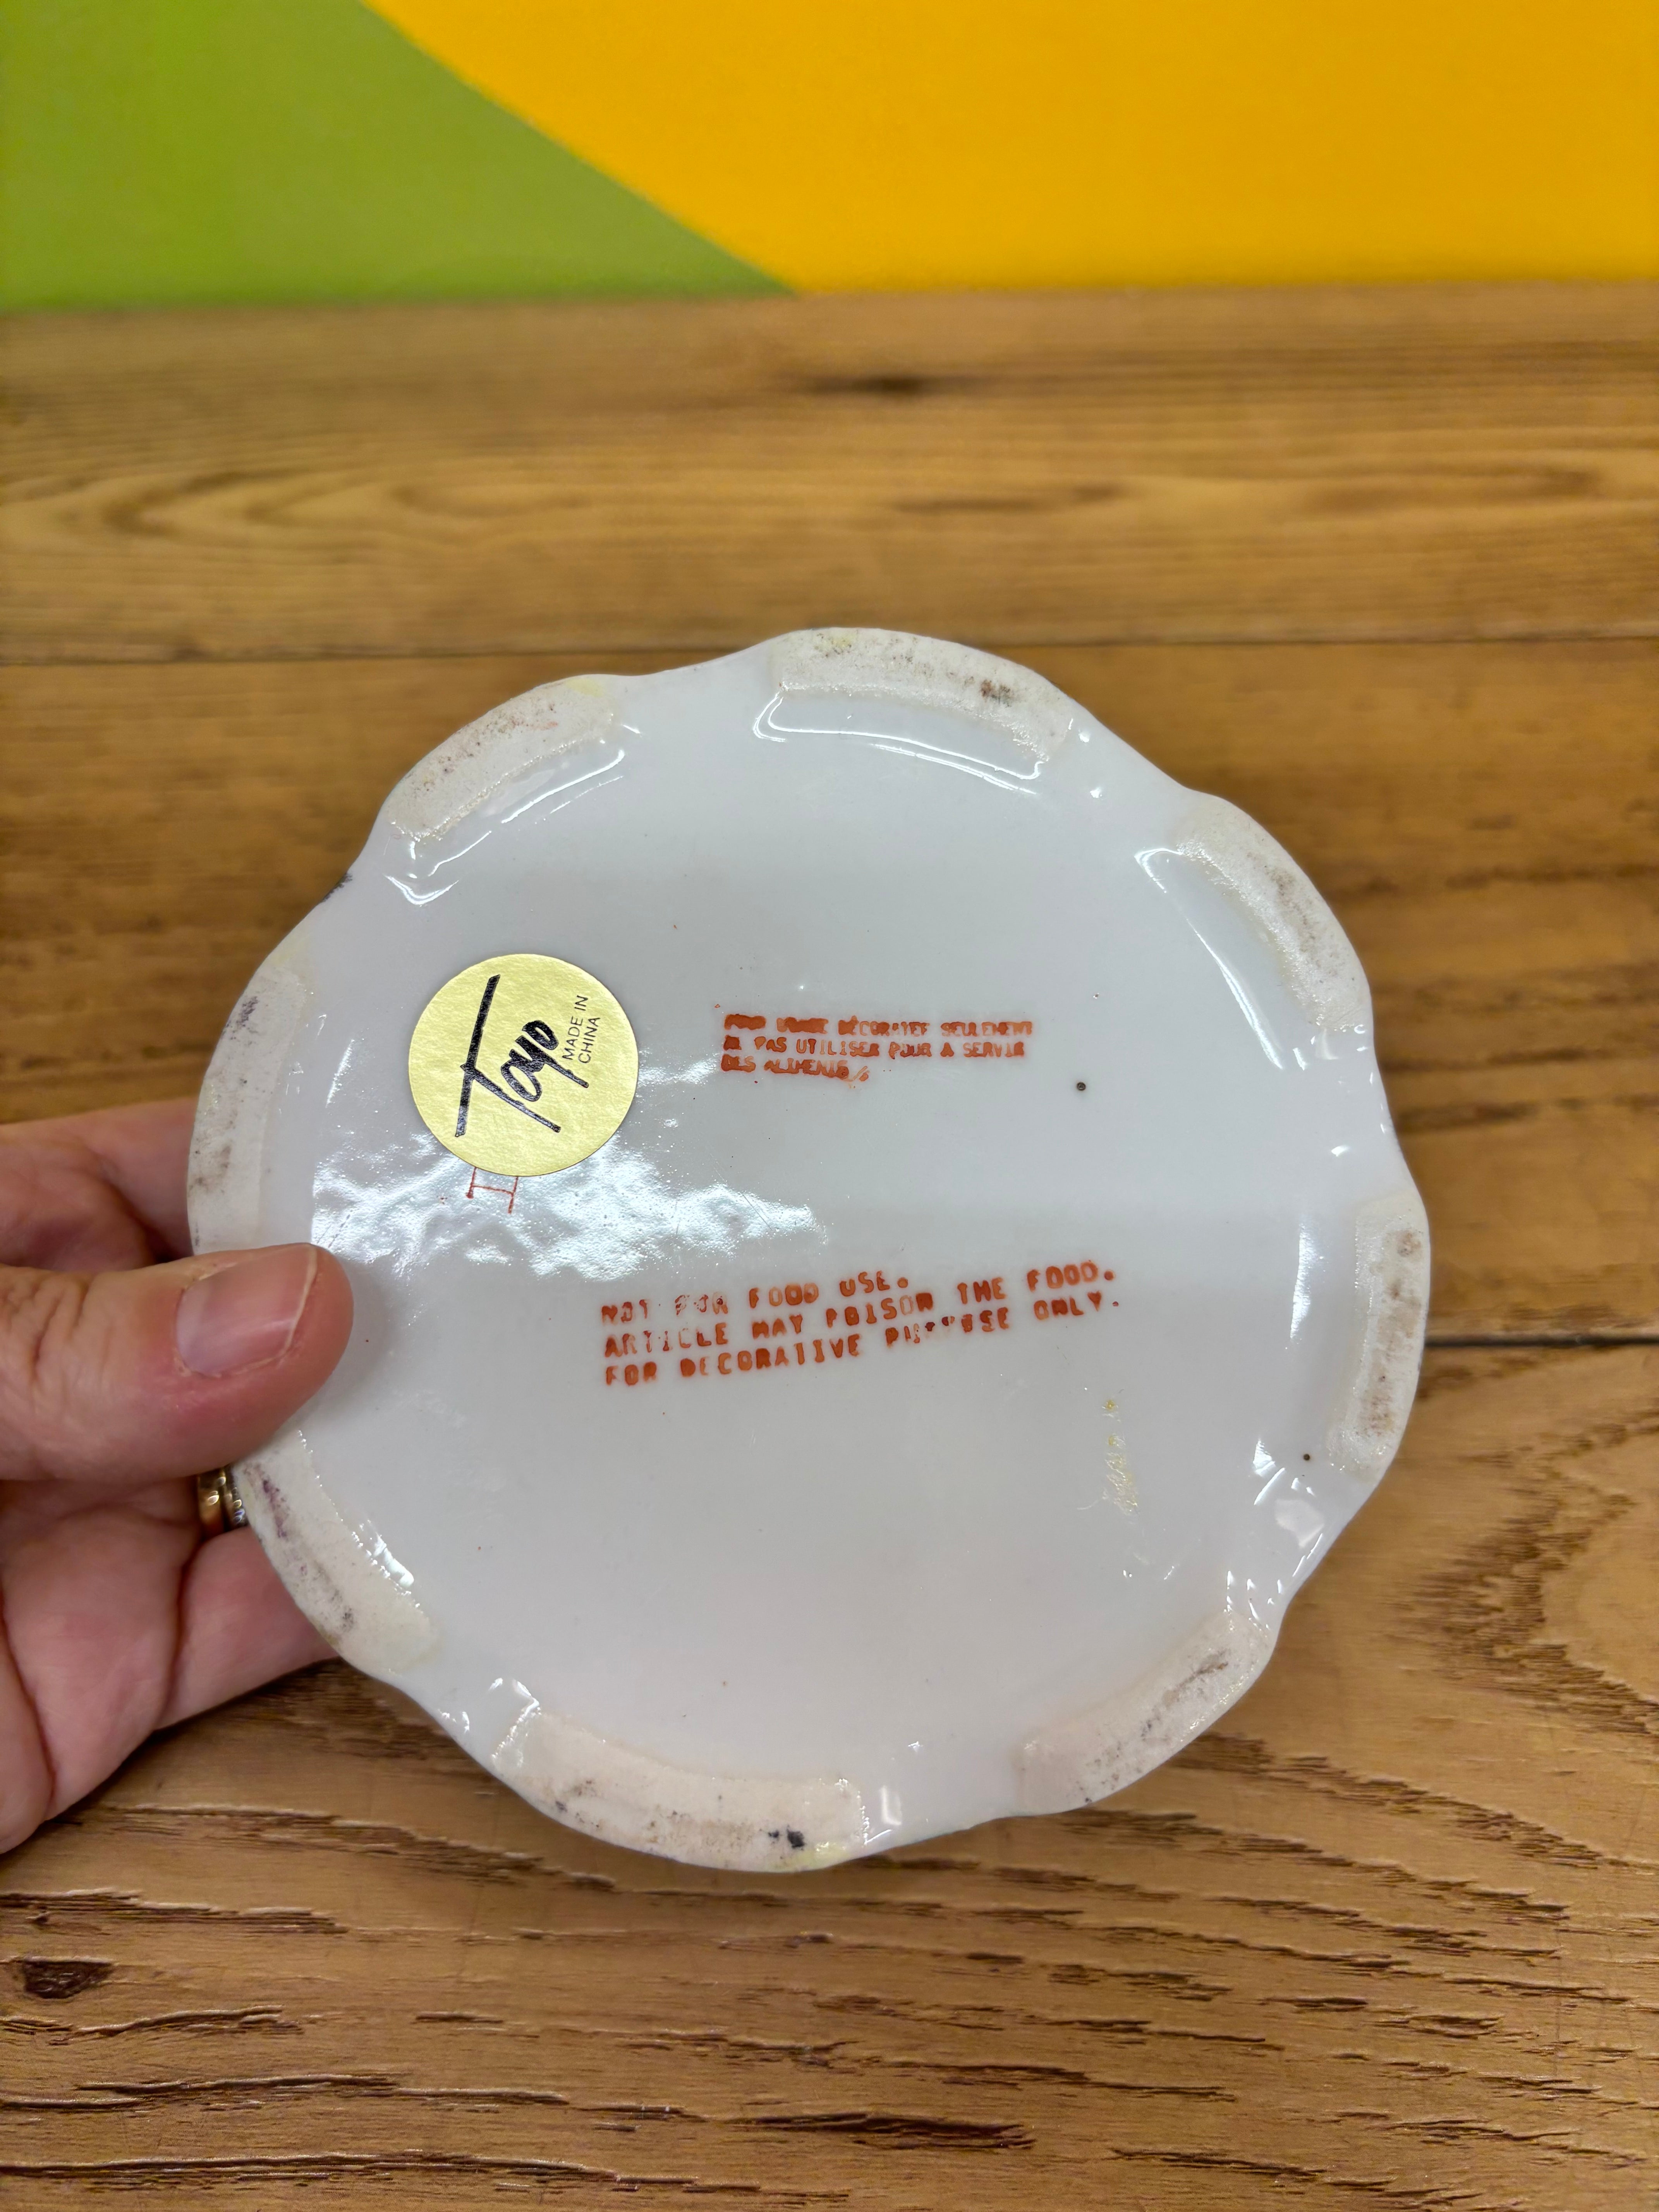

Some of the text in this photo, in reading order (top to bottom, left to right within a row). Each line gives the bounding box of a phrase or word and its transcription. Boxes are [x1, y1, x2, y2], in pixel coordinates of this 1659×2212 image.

[562, 995, 588, 1060] MADE IN
[579, 1017, 600, 1063] CHINA
[754, 1036, 787, 1053] PAS
[796, 1038, 880, 1058] UTILISER
[940, 1042, 954, 1058] A
[963, 1041, 1025, 1058] SERVIR
[455, 974, 589, 1137] Toyo
[601, 1299, 648, 1325] NOT
[748, 1283, 820, 1309] FOOD
[839, 1270, 908, 1297] USE.
[604, 1259, 1115, 1358] ARTICLE MAY POISON THE FOOD.
[605, 1361, 658, 1386] FOR
[679, 1333, 861, 1378] DECORATIVE
